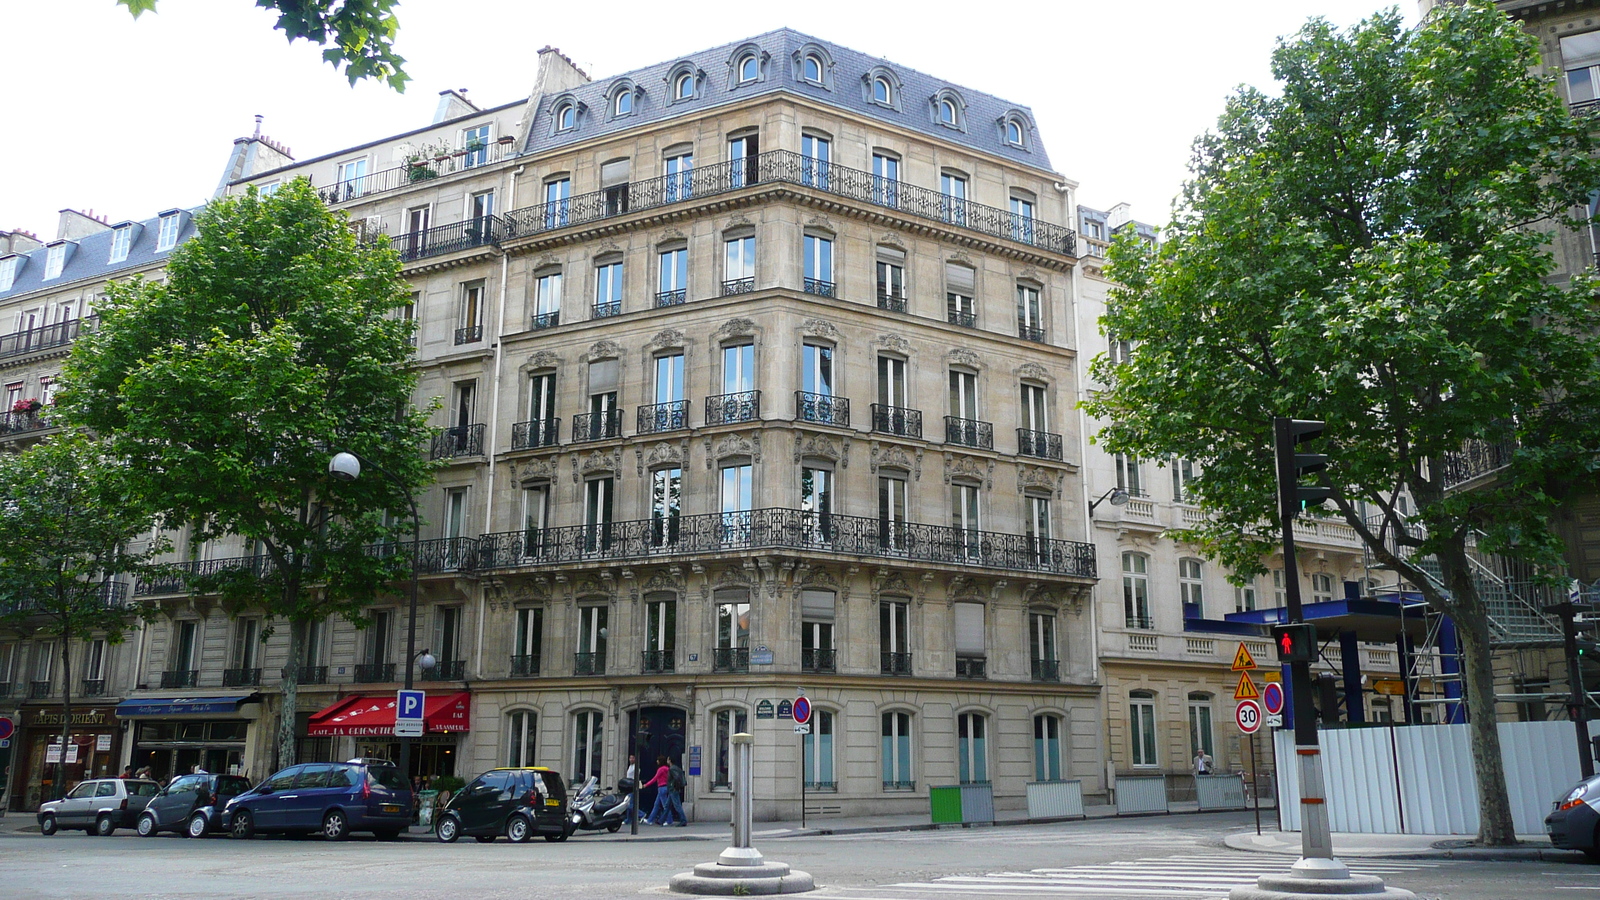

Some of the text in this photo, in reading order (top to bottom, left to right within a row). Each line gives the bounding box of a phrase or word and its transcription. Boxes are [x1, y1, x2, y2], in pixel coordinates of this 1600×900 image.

[405, 696, 417, 714] P
[33, 714, 58, 725] TAPIS
[1241, 710, 1256, 723] 30
[333, 727, 344, 735] LA
